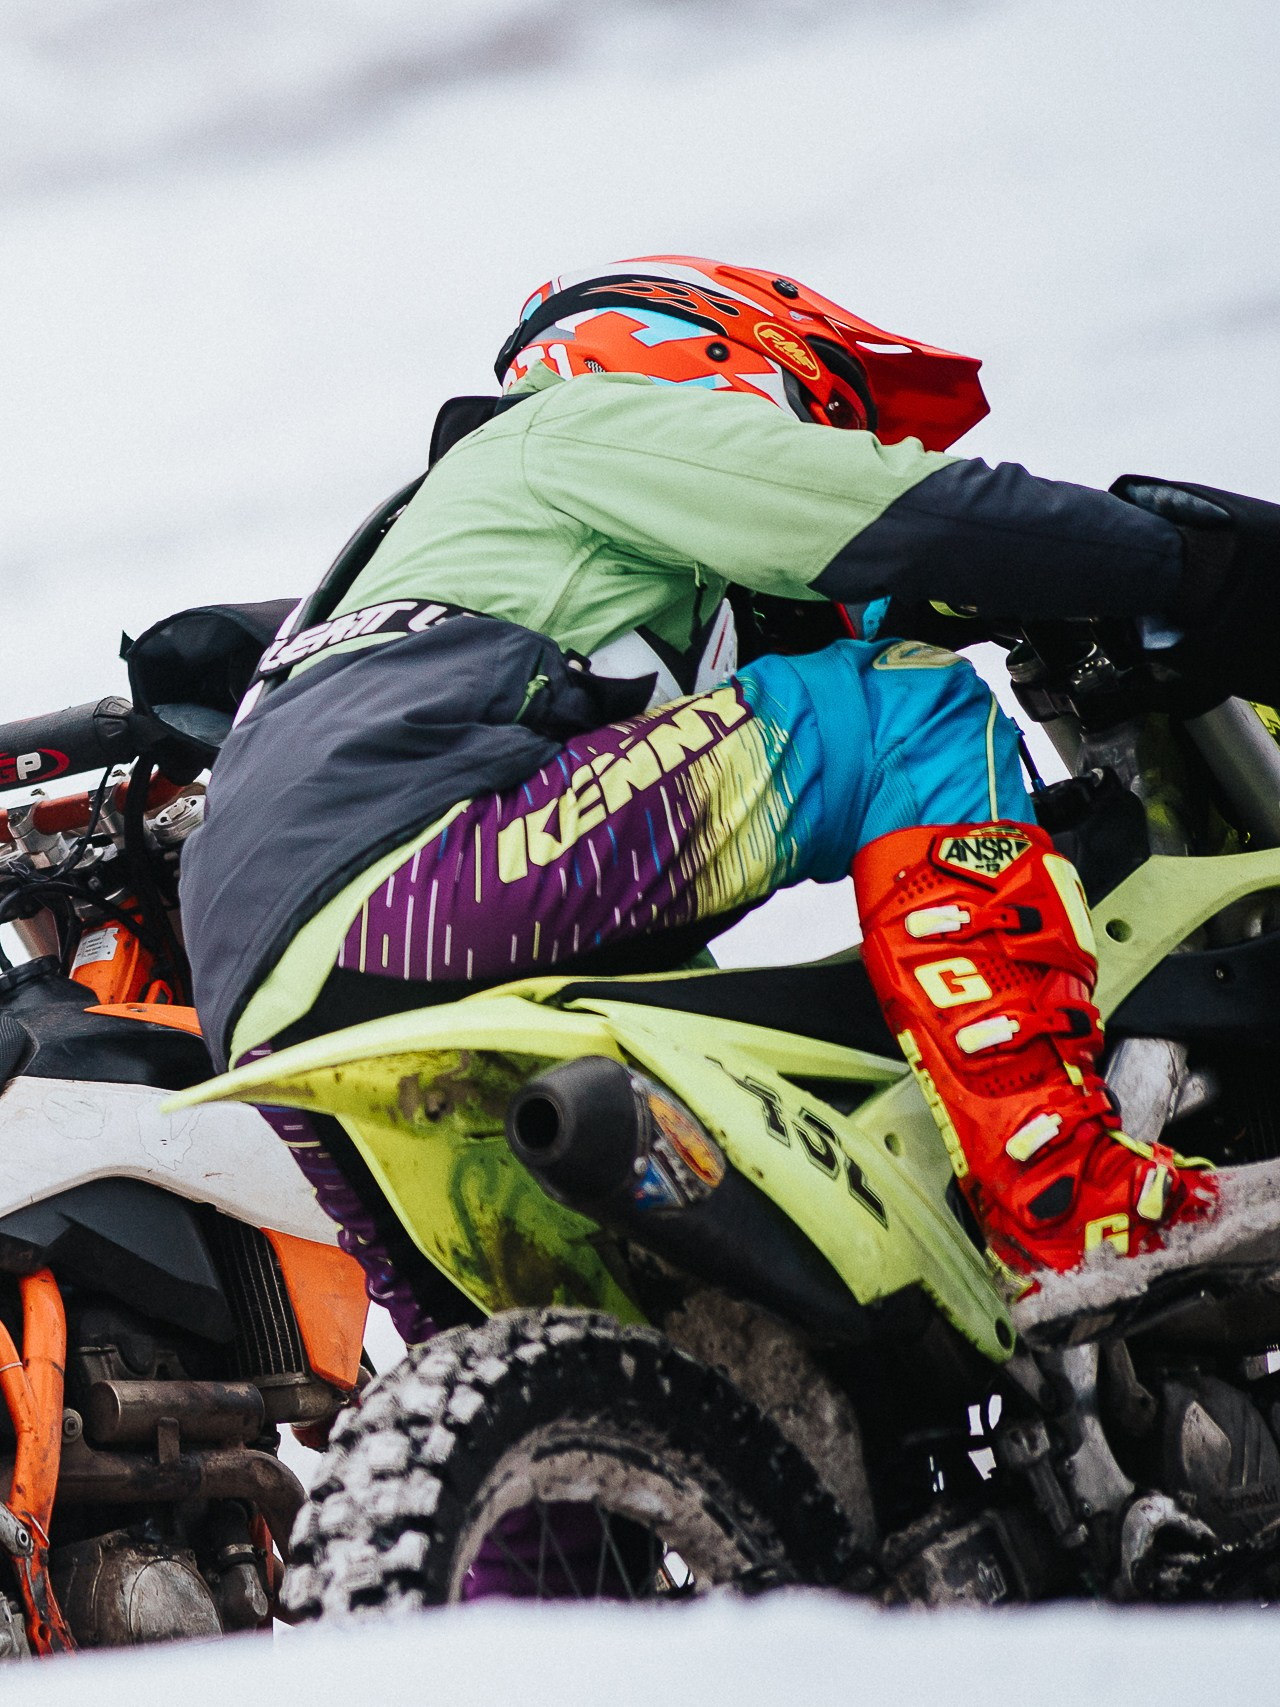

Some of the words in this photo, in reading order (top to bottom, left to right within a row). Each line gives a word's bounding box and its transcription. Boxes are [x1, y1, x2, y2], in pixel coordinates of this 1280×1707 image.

[759, 328, 817, 370] FMF
[259, 601, 418, 672] LEATT
[498, 687, 747, 884] KENNY
[945, 839, 1014, 862] ANSR
[914, 957, 993, 1009] G
